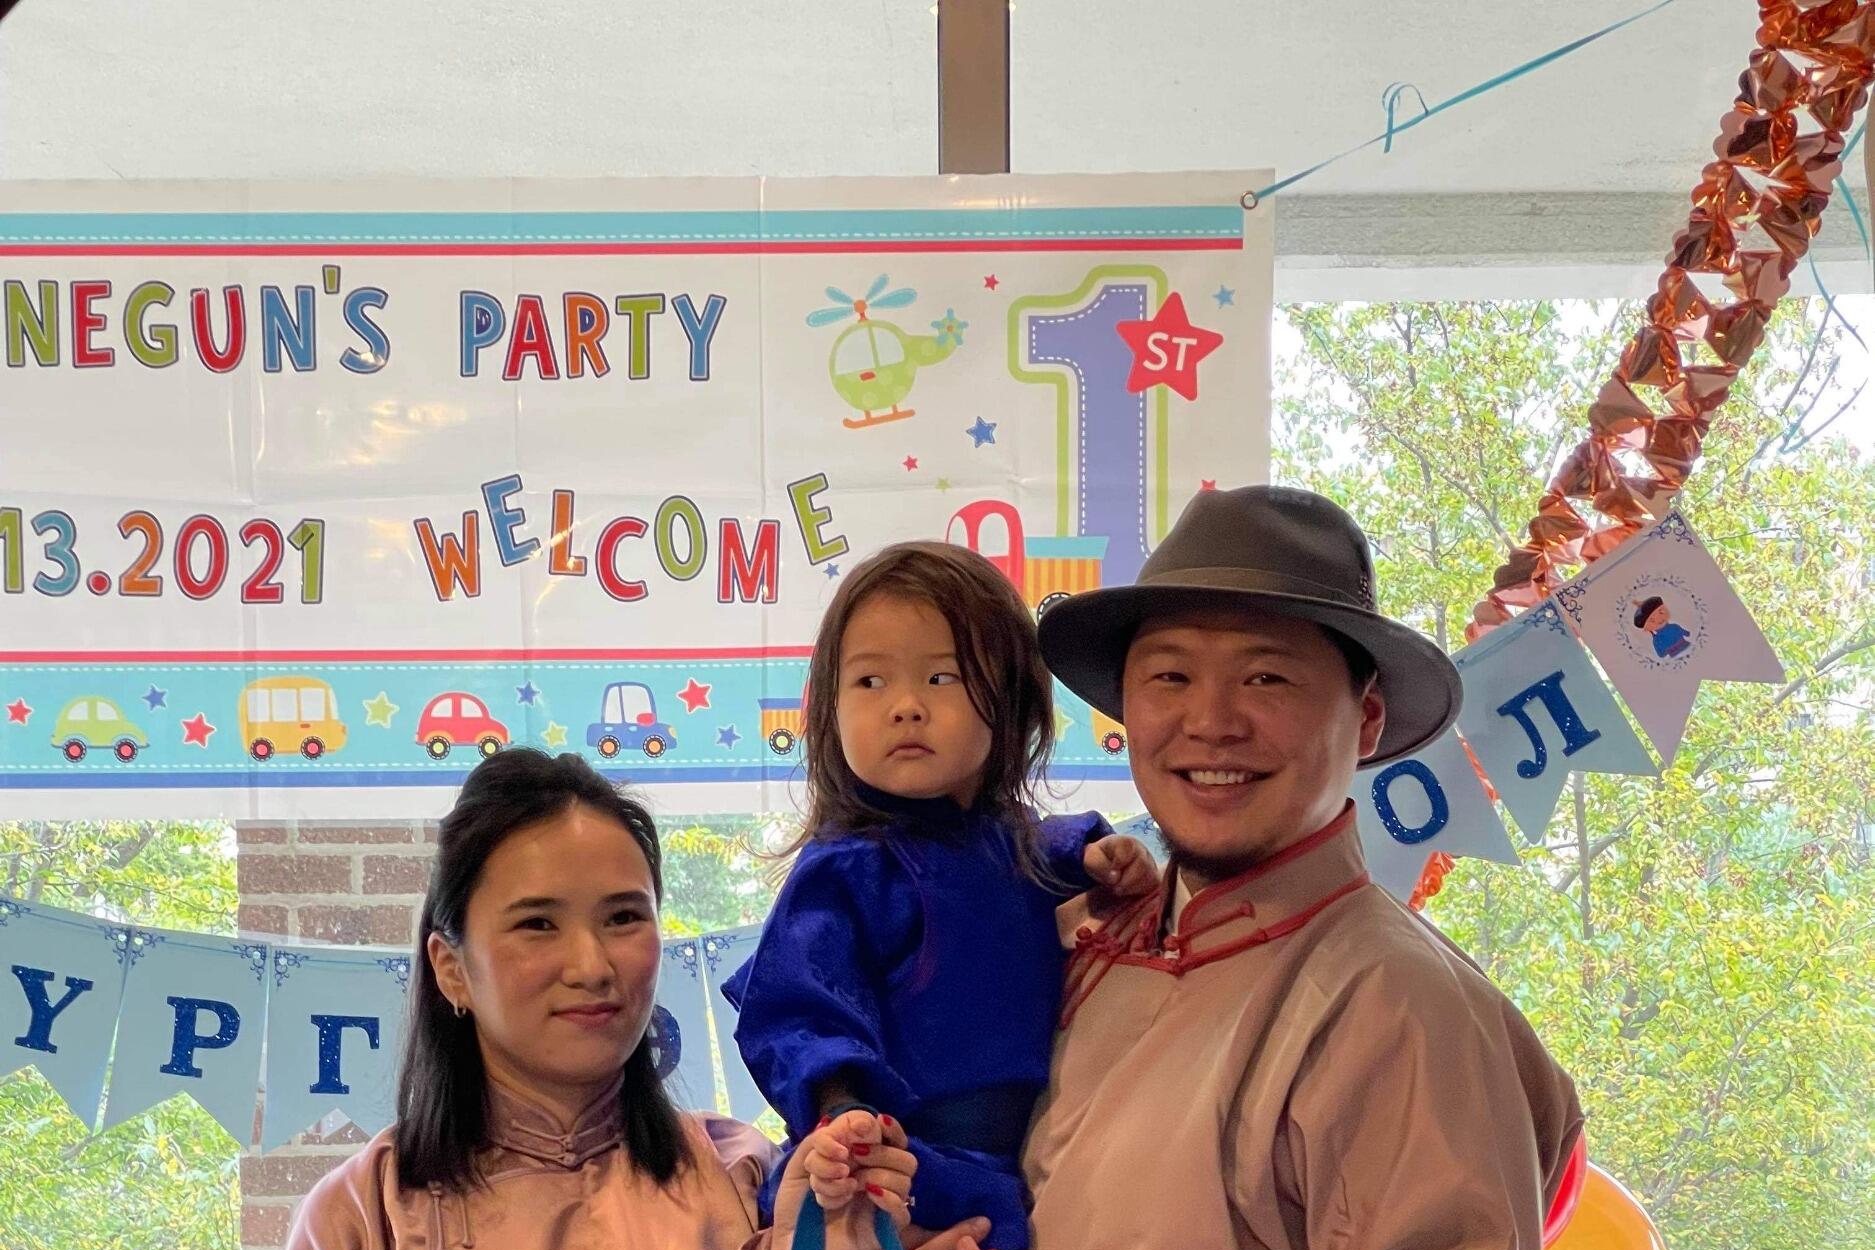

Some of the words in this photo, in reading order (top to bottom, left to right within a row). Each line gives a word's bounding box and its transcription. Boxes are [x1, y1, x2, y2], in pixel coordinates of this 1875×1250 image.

[3, 265, 391, 374] NEGUN'S
[460, 289, 728, 382] PARTY
[1142, 331, 1198, 372] ST
[0, 507, 325, 604] 13.2021
[414, 471, 850, 605] WELCOME
